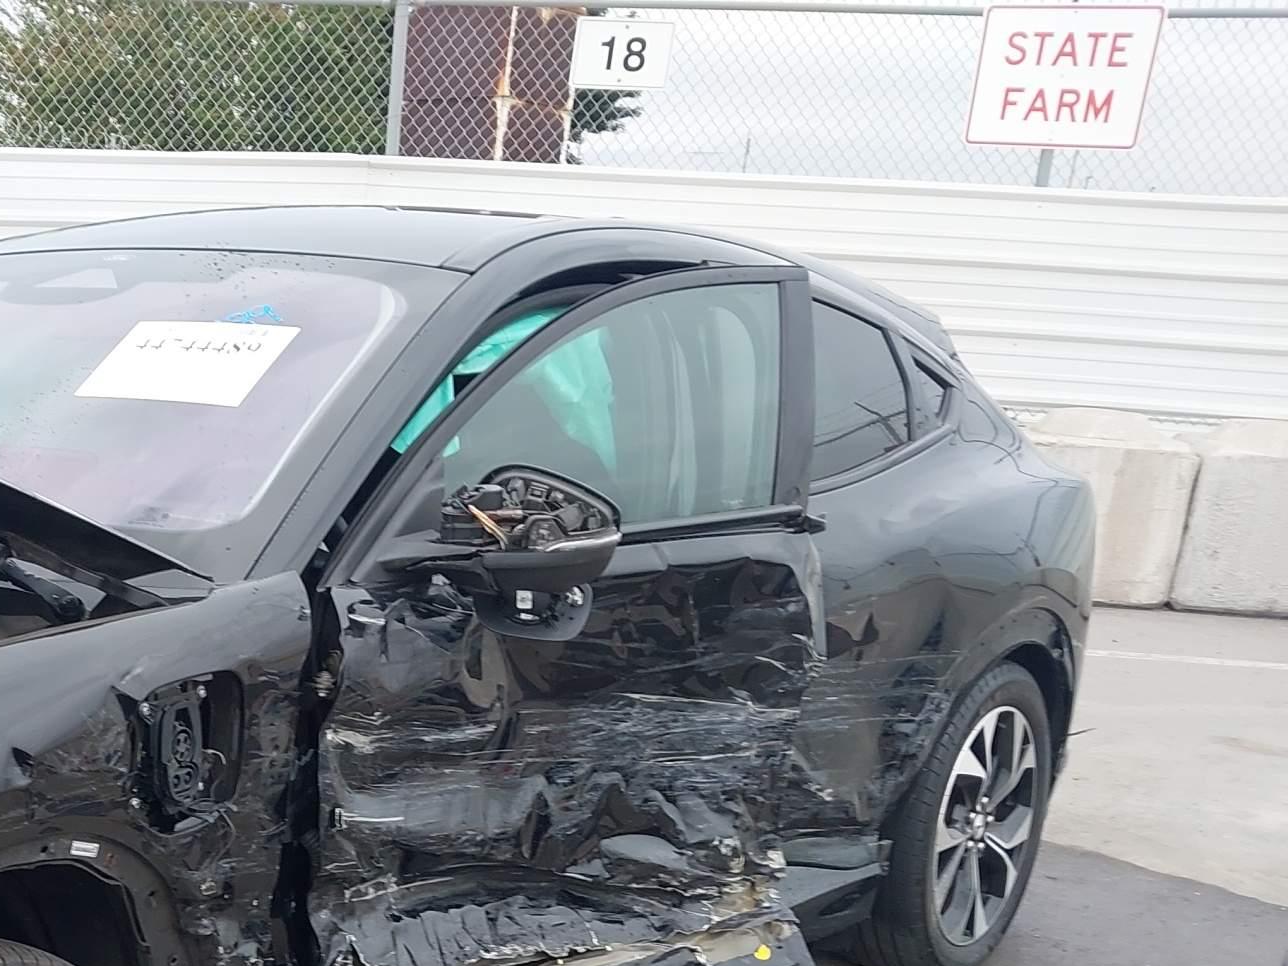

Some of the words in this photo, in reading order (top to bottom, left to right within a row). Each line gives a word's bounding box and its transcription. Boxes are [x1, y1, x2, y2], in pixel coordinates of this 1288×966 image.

[600, 36, 647, 72] 18
[1004, 30, 1133, 69] STATE
[999, 87, 1115, 124] FARM
